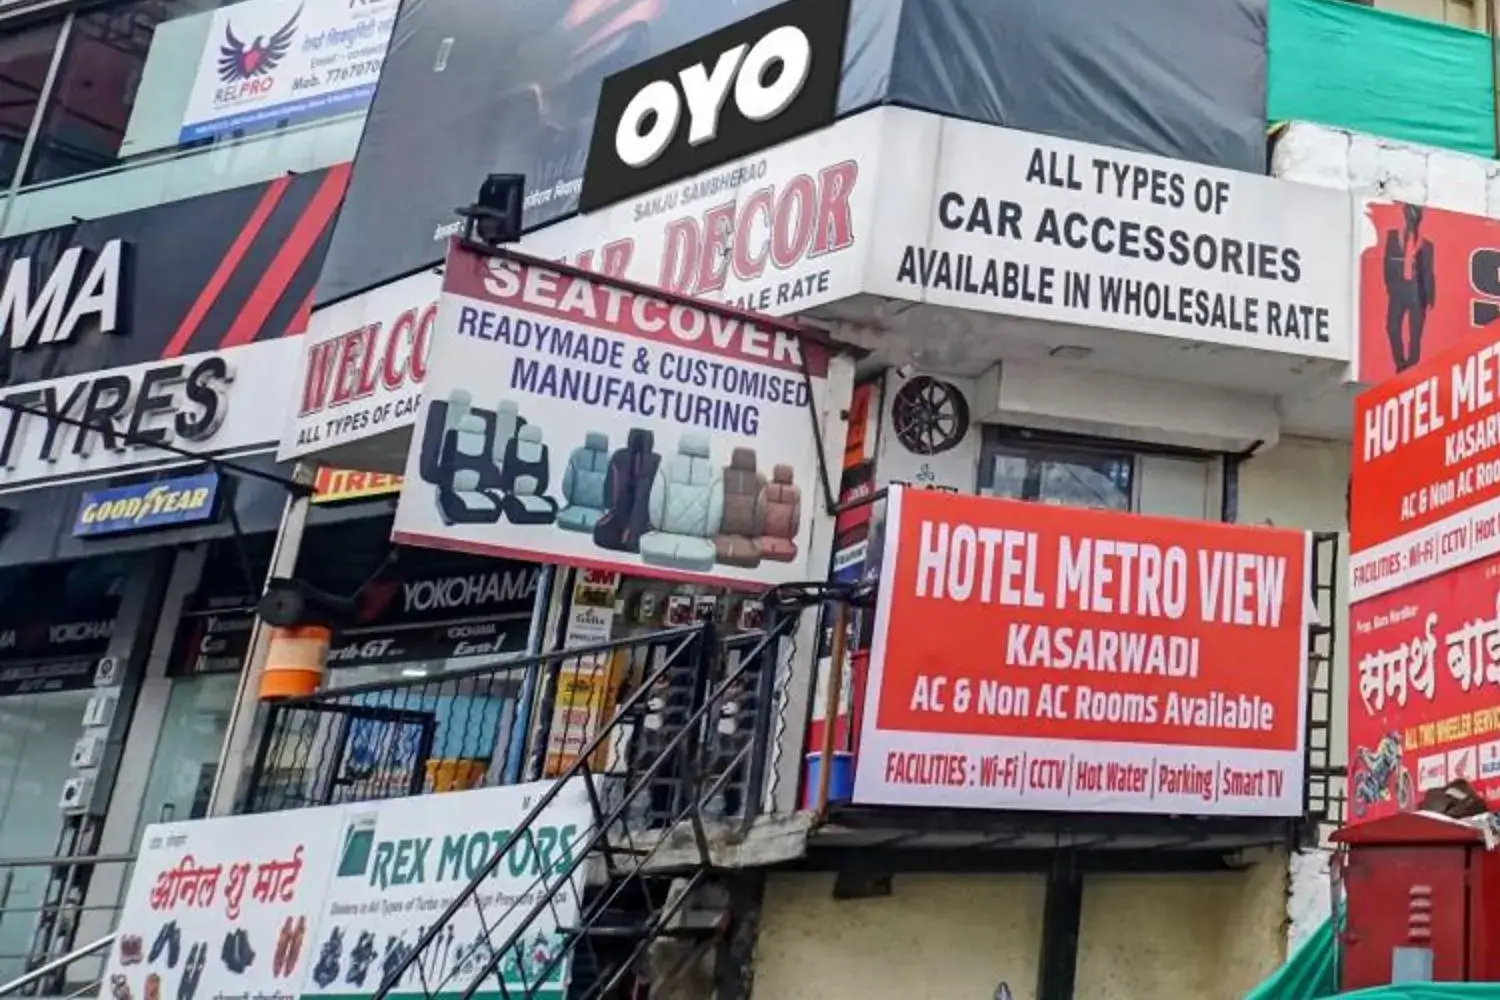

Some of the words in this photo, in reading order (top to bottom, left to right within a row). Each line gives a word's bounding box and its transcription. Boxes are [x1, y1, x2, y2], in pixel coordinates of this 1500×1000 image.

[213, 77, 274, 104] RELPRO
[615, 25, 812, 168] OYO
[633, 191, 677, 222] SANJU
[681, 160, 767, 207] SAMBHERAO
[1025, 147, 1083, 192] ALL
[1092, 158, 1185, 209] TYPES
[1194, 178, 1231, 215] OF
[659, 159, 859, 297] DECOR
[938, 191, 1023, 240] CAR
[1035, 208, 1302, 284] ACCESSORIES
[484, 256, 803, 365] SEATCOVER
[776, 270, 831, 306] RATE
[897, 245, 1055, 304] AVAILABLE
[1063, 269, 1092, 311] IN
[1099, 275, 1258, 334] WHOLESALE
[1266, 301, 1330, 344] RATE
[457, 306, 623, 369] READYMADE
[631, 347, 650, 374] &
[659, 352, 810, 408] CUSTOMISED
[0, 356, 232, 471] TYRES
[296, 425, 320, 447] ALL
[326, 411, 370, 437] TYPES
[372, 402, 395, 424] OF
[510, 357, 760, 436] MANUFACTURING
[1363, 376, 1444, 461] HOTEL
[81, 486, 208, 525] GOODYEAR
[1401, 496, 1417, 521] AC
[1419, 491, 1428, 513] &
[1429, 481, 1455, 511] Non
[1457, 474, 1474, 499] AC
[916, 520, 1044, 607] HOTEL
[1055, 536, 1188, 620] METRO
[1198, 548, 1287, 628] VIEW
[1353, 552, 1401, 588] FACILITIES
[1441, 526, 1468, 556] CCTV
[1475, 515, 1497, 542] Hot
[403, 568, 540, 612] YOKOHAMA
[1005, 623, 1200, 678] KASARWADI
[1359, 612, 1438, 715] समर्थ
[910, 675, 944, 713] AC
[953, 680, 972, 714] &
[977, 680, 1030, 718] Non
[1035, 683, 1069, 720] AC
[1075, 686, 1158, 724] Rooms
[1164, 691, 1274, 731] Available
[1405, 726, 1418, 751] ALL
[1419, 722, 1435, 747] TWO
[1437, 713, 1472, 743] WHEELER
[884, 753, 967, 786] FACILITIES
[980, 755, 1019, 788] Wi-Fi
[1030, 759, 1066, 790] CCTV
[1076, 759, 1103, 791] Hot
[1106, 762, 1148, 793] Water
[1159, 765, 1213, 800] Parking
[1223, 766, 1265, 796] Smart
[1266, 769, 1284, 798] TV
[151, 855, 222, 910] अनिल
[224, 862, 251, 920] शु
[253, 844, 304, 904] मार्ट
[370, 837, 433, 891] REX
[436, 824, 578, 882] MOTORS
